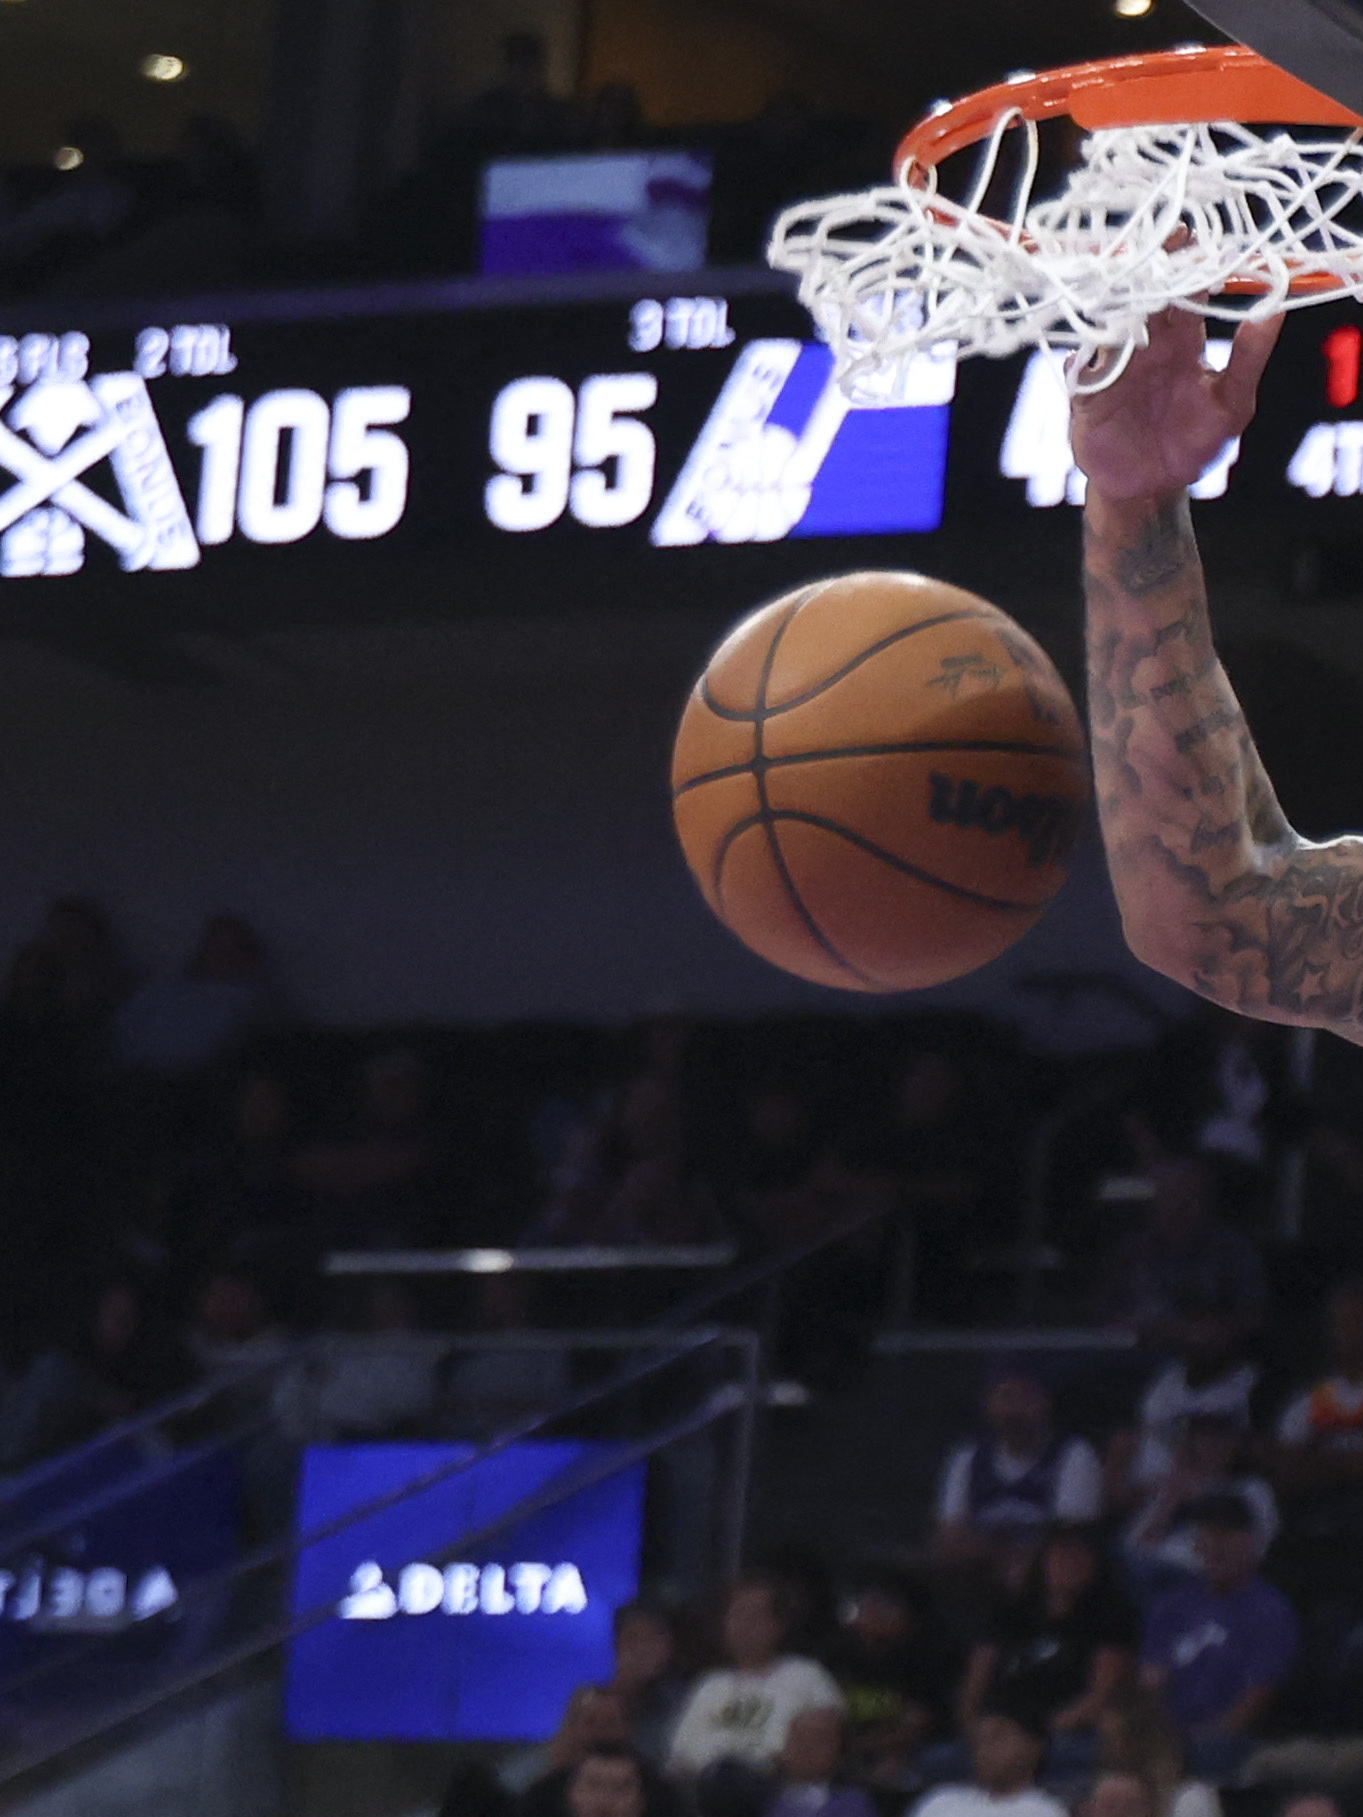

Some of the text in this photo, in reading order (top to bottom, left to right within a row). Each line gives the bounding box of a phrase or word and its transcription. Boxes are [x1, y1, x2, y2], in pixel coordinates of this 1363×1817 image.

[133, 323, 238, 379] 2 TOL
[187, 384, 411, 545] 105
[484, 372, 658, 533] 95
[399, 1562, 588, 1615] DELTA
